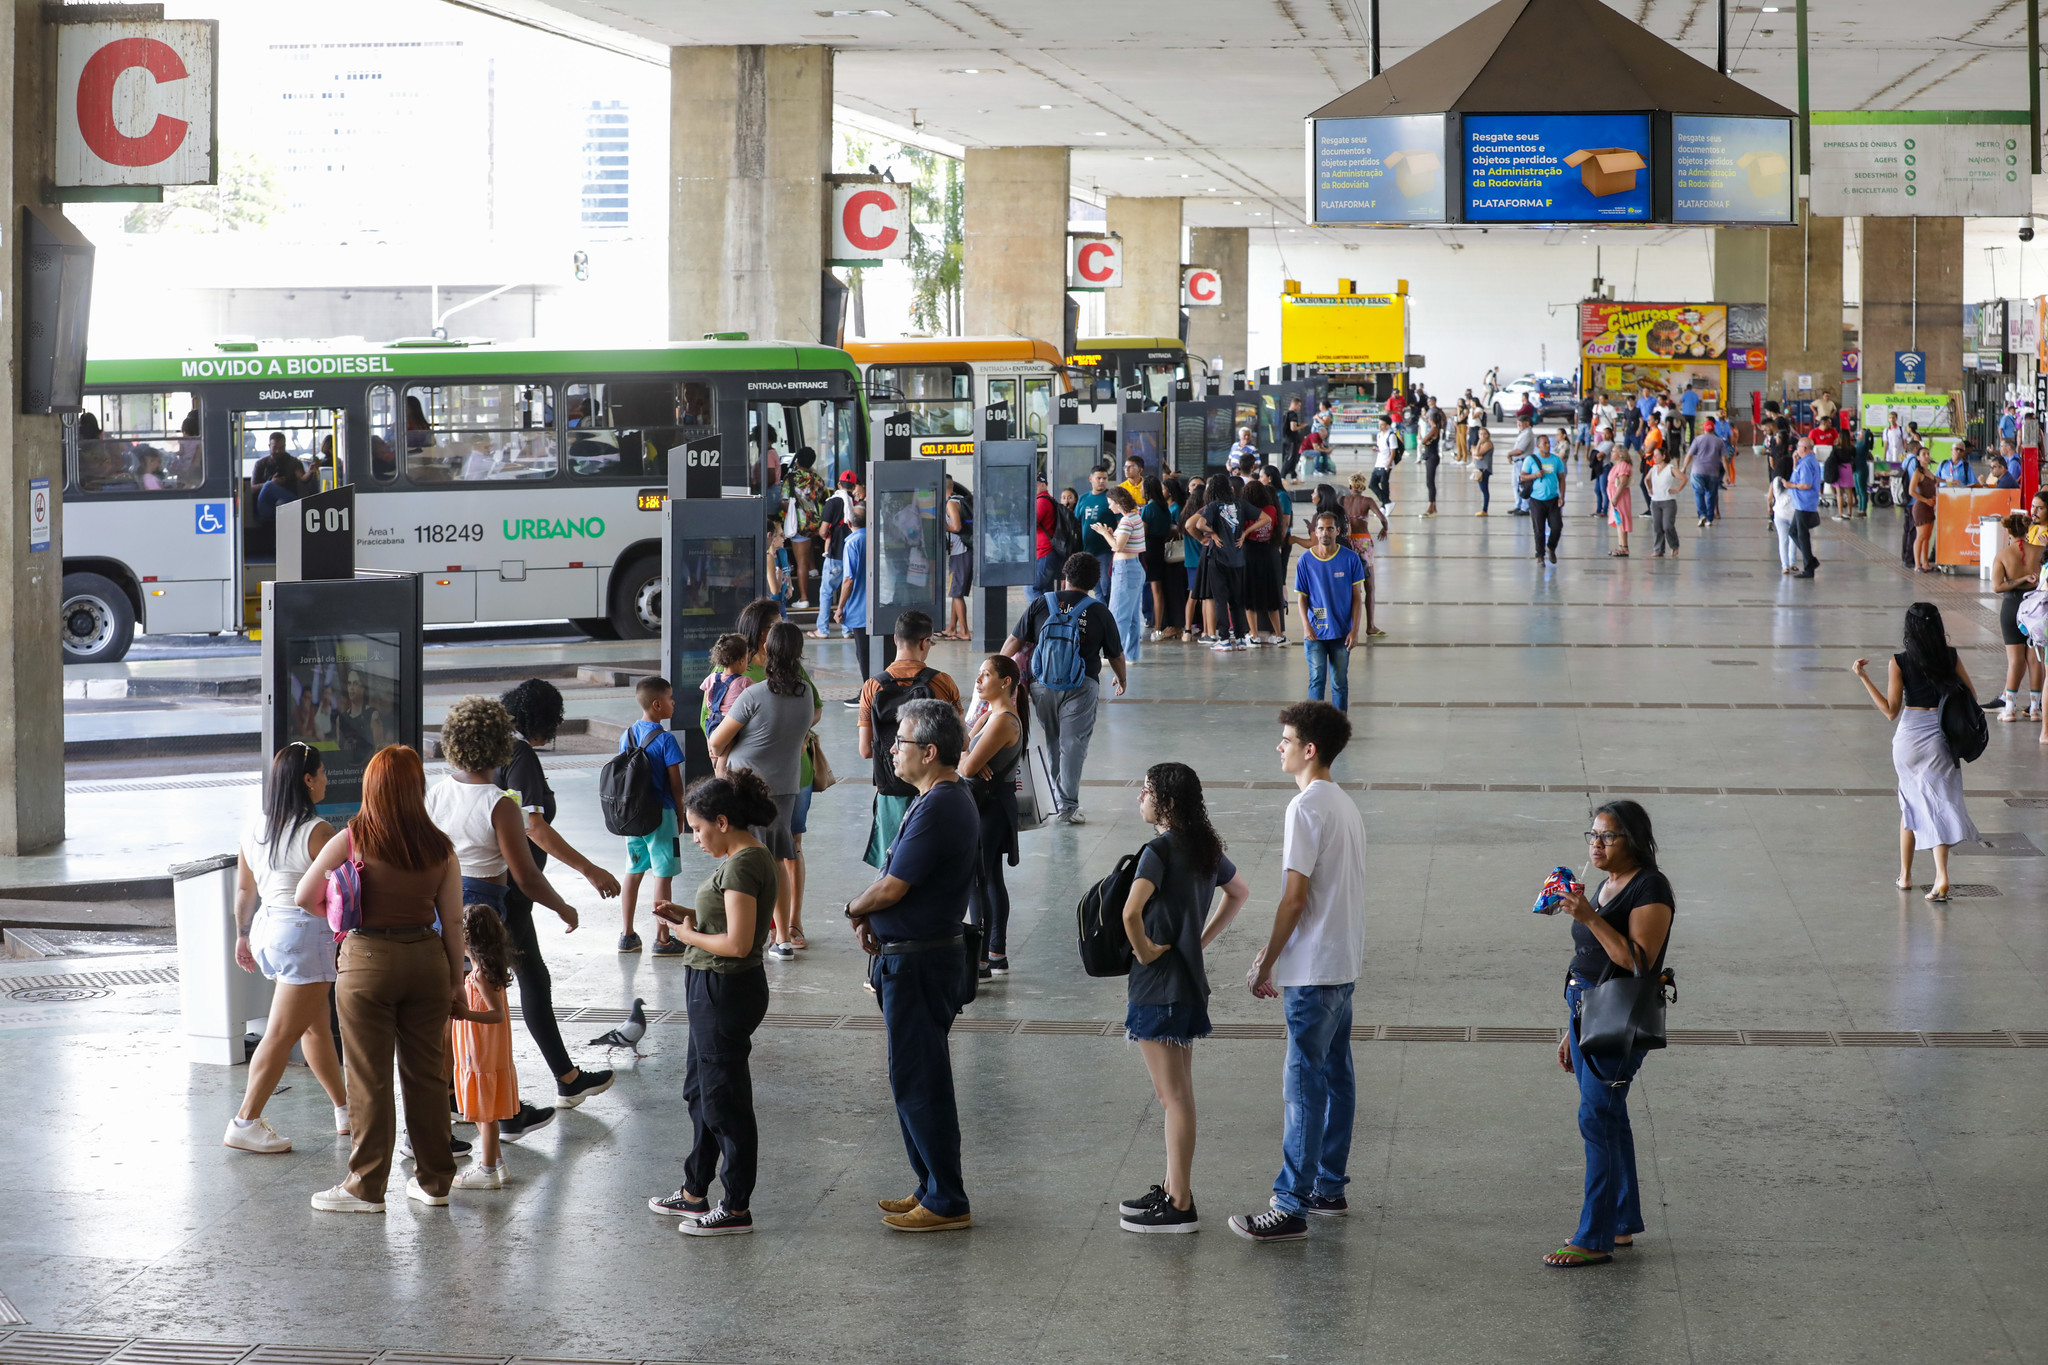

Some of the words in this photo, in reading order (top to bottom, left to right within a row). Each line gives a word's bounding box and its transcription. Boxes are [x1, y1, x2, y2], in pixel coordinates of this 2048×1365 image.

[76, 37, 189, 167] C
[1321, 136, 1350, 146] Resgate
[1472, 133, 1514, 142] Resgate
[1678, 134, 1705, 143] Resgate
[1321, 148, 1366, 156] documentos
[1472, 144, 1536, 153] documentos
[1678, 145, 1719, 154] documentos
[1321, 159, 1347, 168] objetos
[1349, 158, 1380, 168] perdidos
[1472, 156, 1510, 165] objetos
[1513, 156, 1558, 165] perdidos
[1678, 158, 1703, 167] objetos
[1704, 158, 1733, 168] perdidos
[1332, 169, 1383, 179] Administração
[1488, 167, 1562, 178] Administração
[1688, 168, 1736, 179] Administração
[1321, 181, 1330, 189] da
[1332, 180, 1369, 189] Rodoviária
[1473, 179, 1485, 187] da
[1488, 178, 1542, 187] Rodoviária
[1688, 180, 1723, 188] Rodoviária
[1473, 200, 1543, 208] PLATAFORMA
[1678, 200, 1724, 208] PLATAFORMA
[842, 190, 898, 251] C
[1078, 243, 1114, 282] C
[1189, 272, 1216, 300] C
[1608, 308, 1671, 332] Churros
[182, 359, 263, 378] MOVIDO
[268, 359, 283, 374] A
[288, 356, 394, 374] BIODIESEL
[748, 382, 784, 391] ENTRADA
[787, 381, 828, 390] ENTRANCE
[259, 390, 287, 400] SAÍDA
[293, 390, 314, 398] EXIT
[1126, 391, 1131, 399] C
[1060, 398, 1066, 408] C
[1067, 398, 1078, 407] 05
[987, 410, 994, 420] C
[995, 410, 1007, 420] 04
[885, 424, 893, 436] C
[895, 424, 910, 436] 03
[687, 450, 698, 467] C
[700, 450, 720, 466] 02
[306, 508, 320, 532] C
[325, 508, 349, 532] 01
[368, 527, 388, 536] Área
[414, 523, 484, 543] 118249
[503, 517, 605, 540] URBANO
